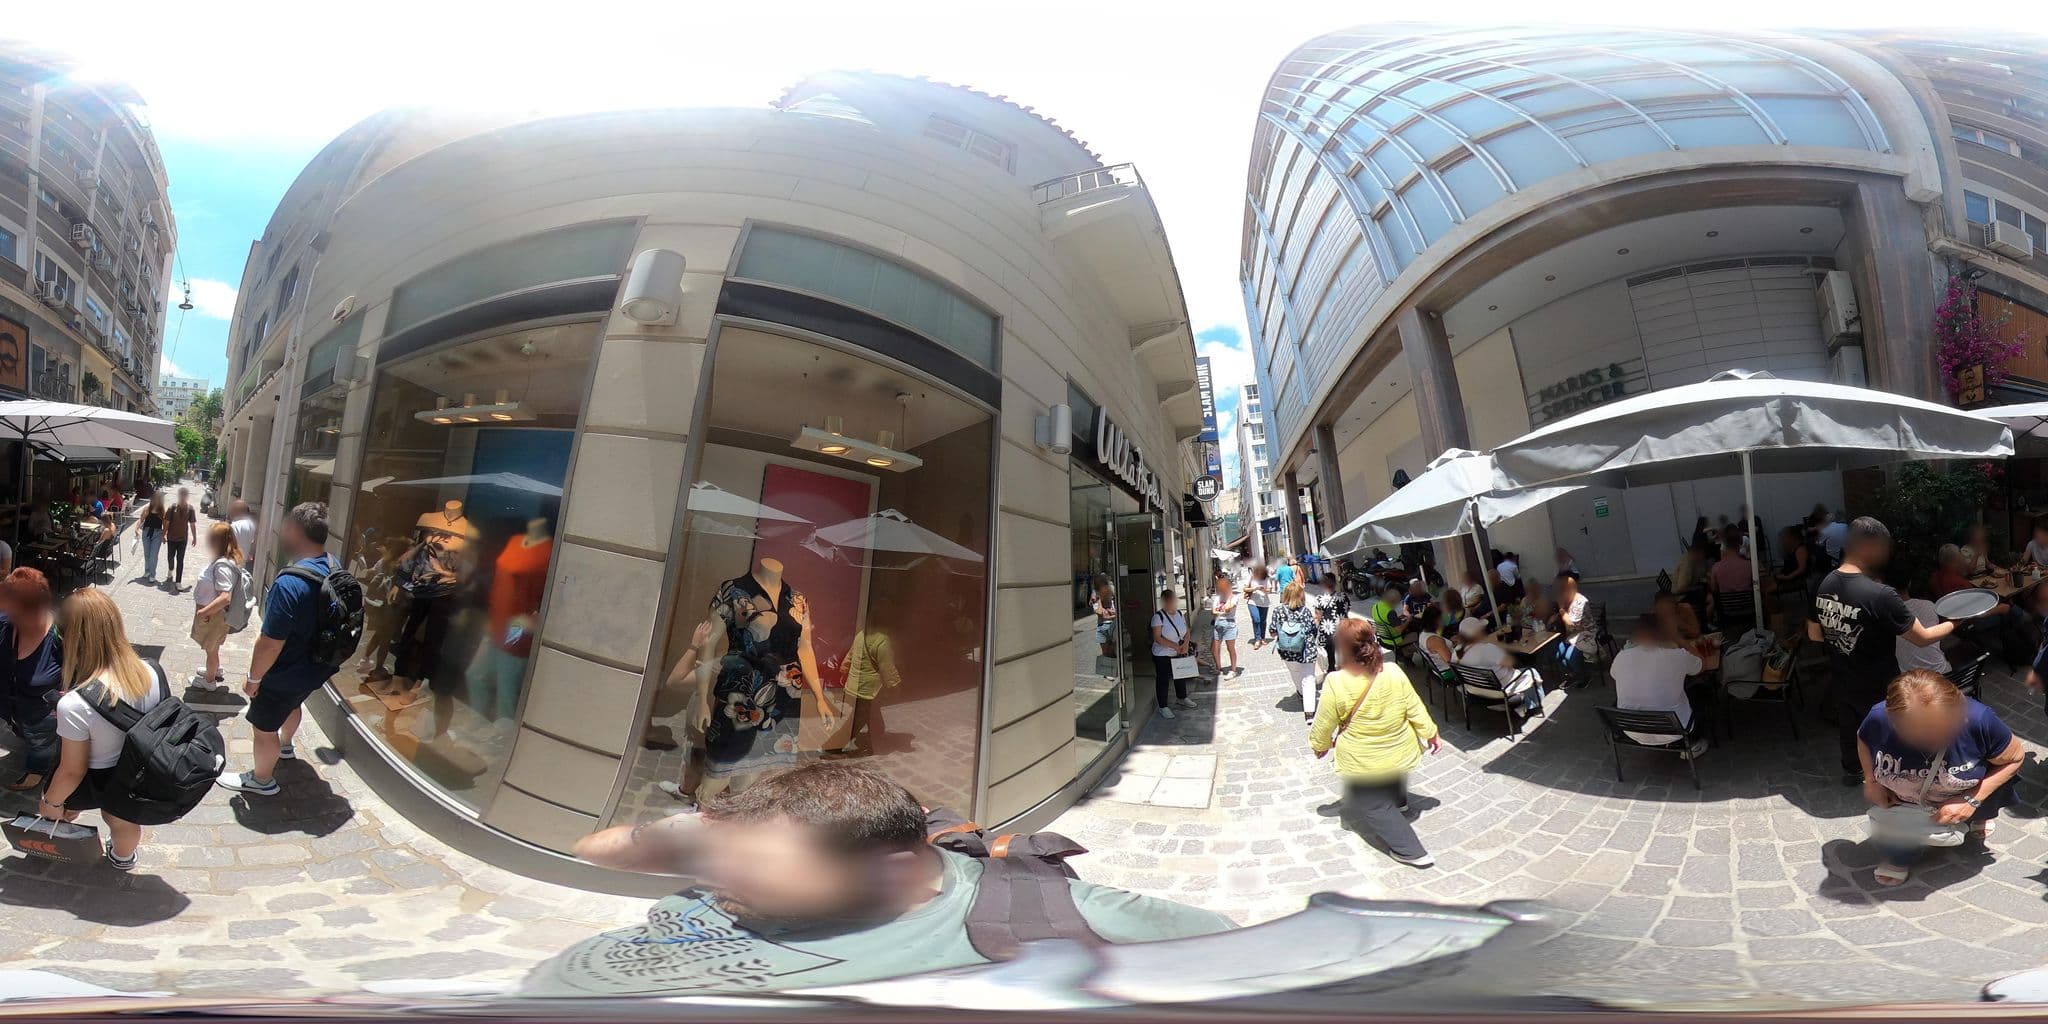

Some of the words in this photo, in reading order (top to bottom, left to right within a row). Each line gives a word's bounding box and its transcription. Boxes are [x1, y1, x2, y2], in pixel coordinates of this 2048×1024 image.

[1196, 363, 1210, 389] DUNK
[1540, 368, 1602, 402] MARKS
[1608, 363, 1623, 378] &
[1200, 391, 1213, 418] SLAM
[1542, 383, 1624, 421] SPENCER
[1097, 404, 1136, 486] Ulla
[1197, 479, 1215, 489] SLAM
[1198, 487, 1216, 496] DUNK
[1816, 597, 1861, 620] DRINK
